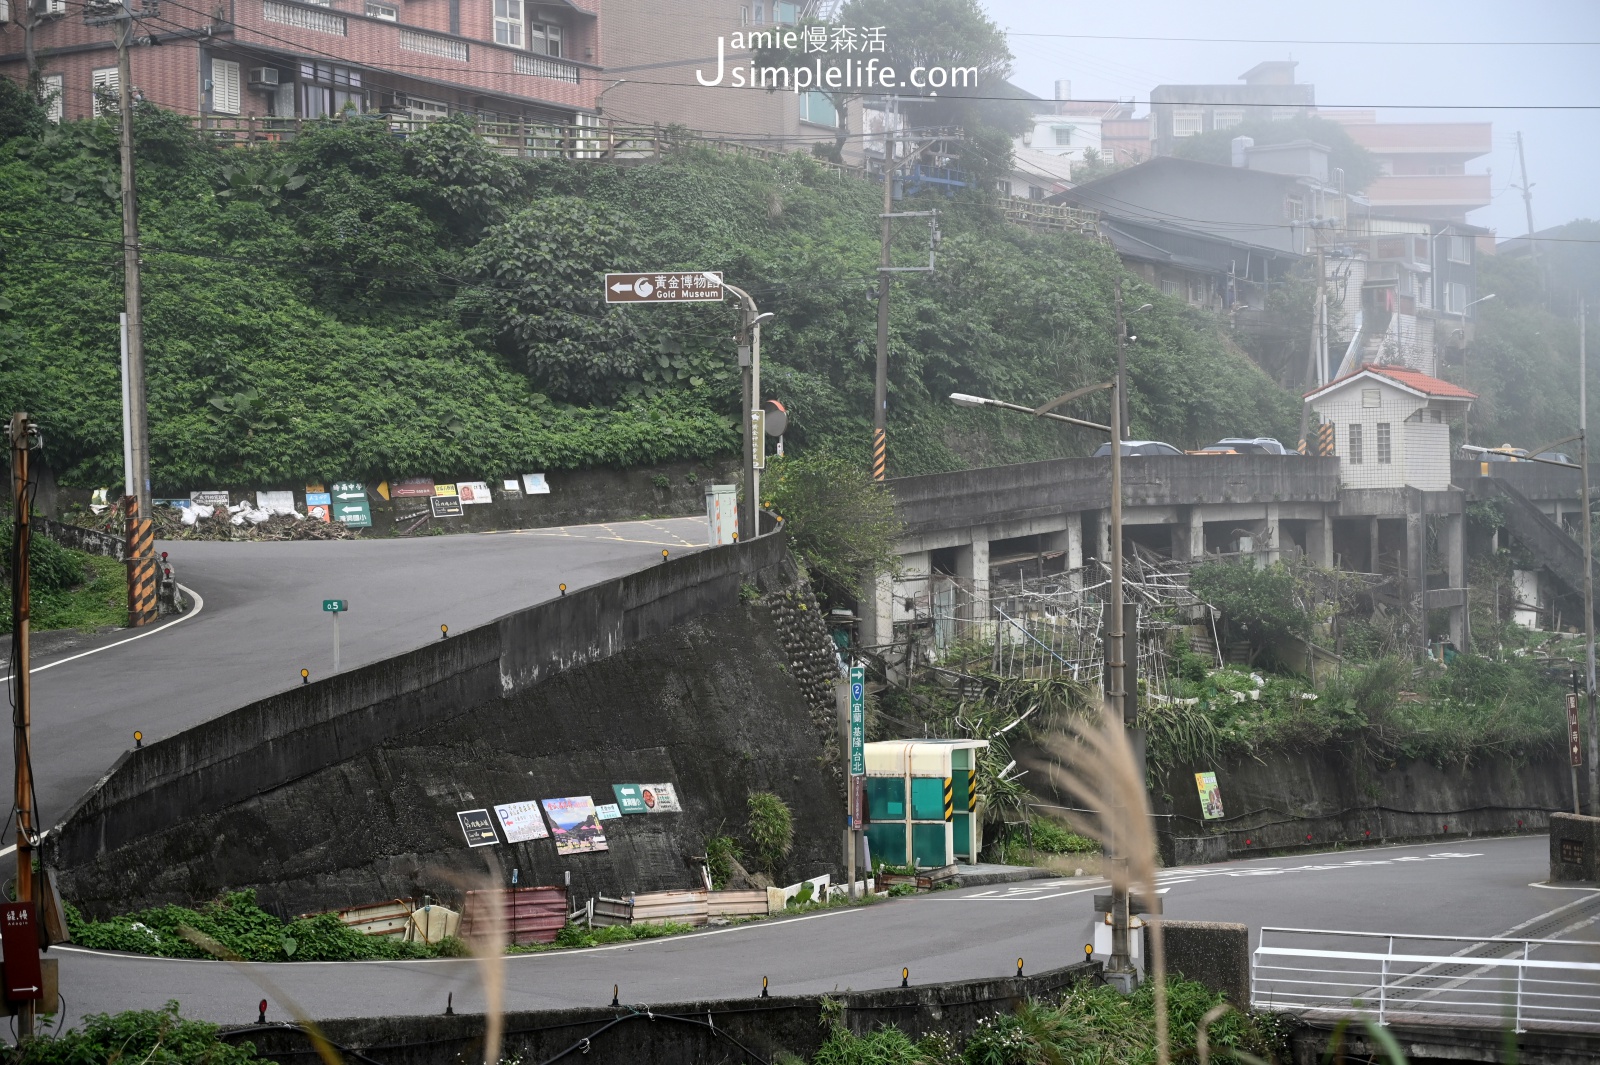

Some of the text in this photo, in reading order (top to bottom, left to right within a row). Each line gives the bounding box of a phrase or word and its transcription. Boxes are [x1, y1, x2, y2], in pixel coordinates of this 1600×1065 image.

[656, 289, 719, 299] Gold Museum
[854, 685, 860, 694] 2
[498, 808, 509, 827] P
